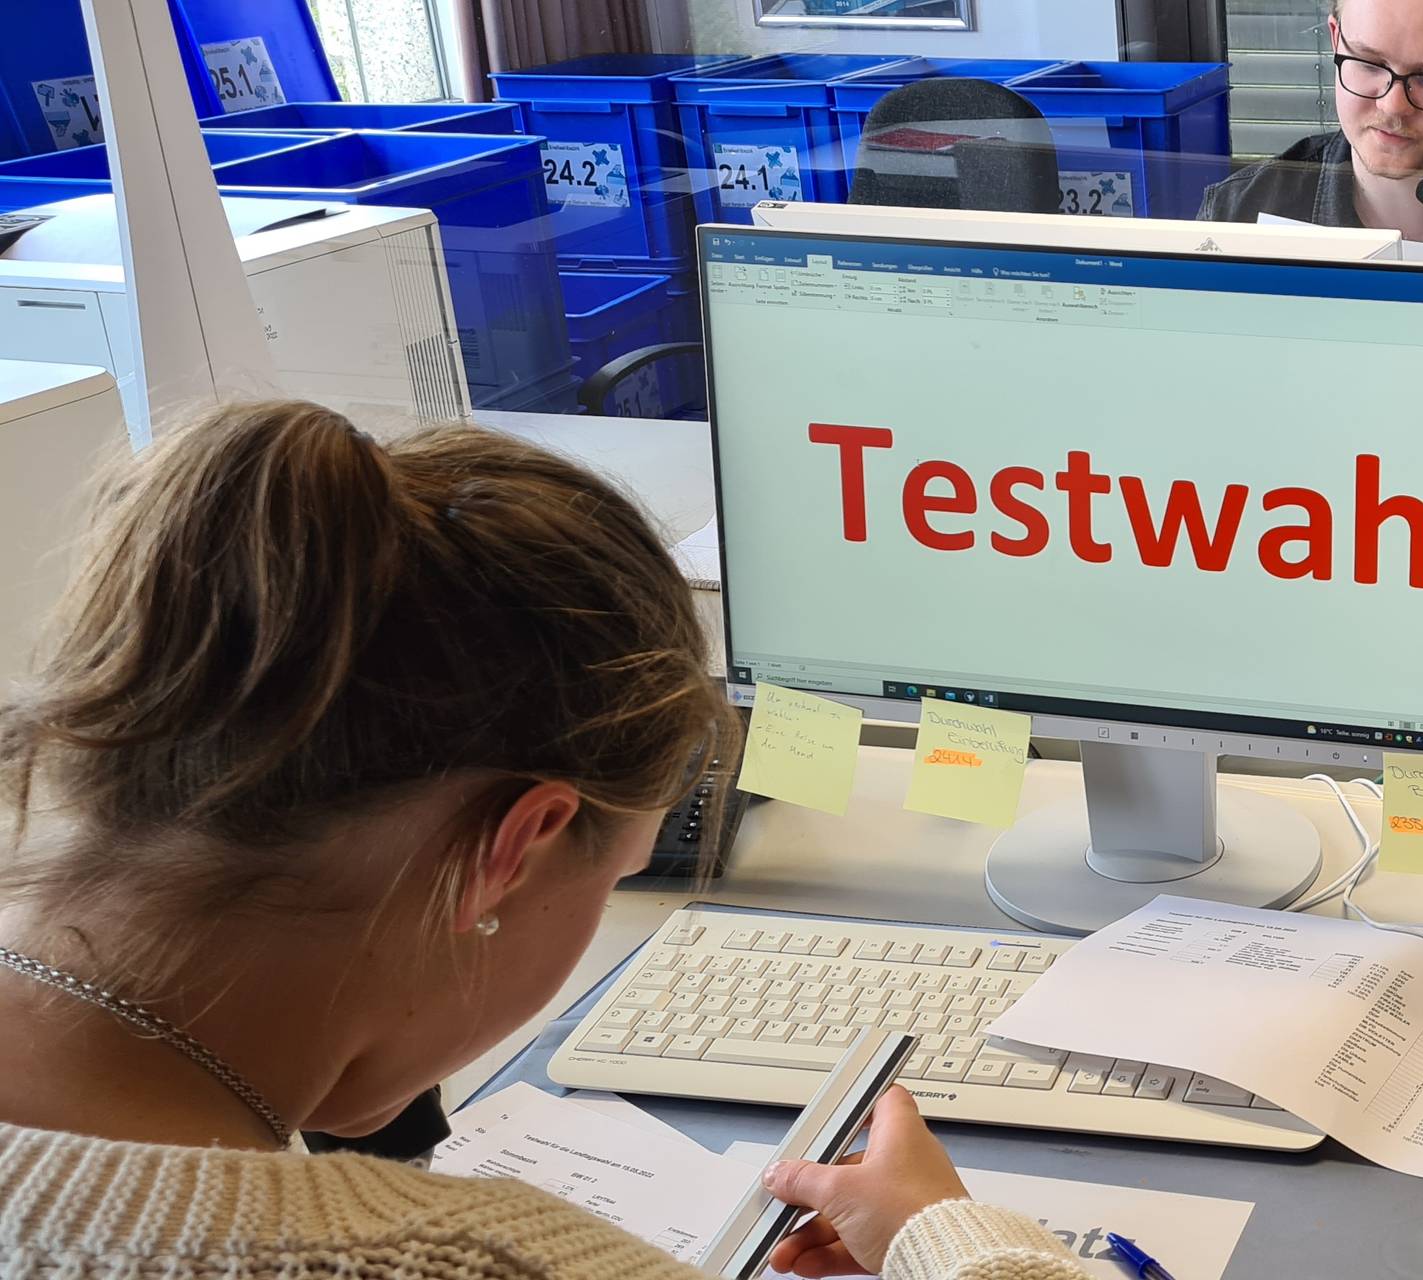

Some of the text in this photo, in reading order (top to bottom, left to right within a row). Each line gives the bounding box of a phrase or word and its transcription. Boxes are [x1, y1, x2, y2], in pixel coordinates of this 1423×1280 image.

[544, 159, 597, 187] 24.2
[719, 164, 768, 191] 24.1
[927, 711, 997, 737] Durchwahl
[523, 1134, 551, 1147] Testwahl
[569, 1149, 613, 1167] Landtagswahl
